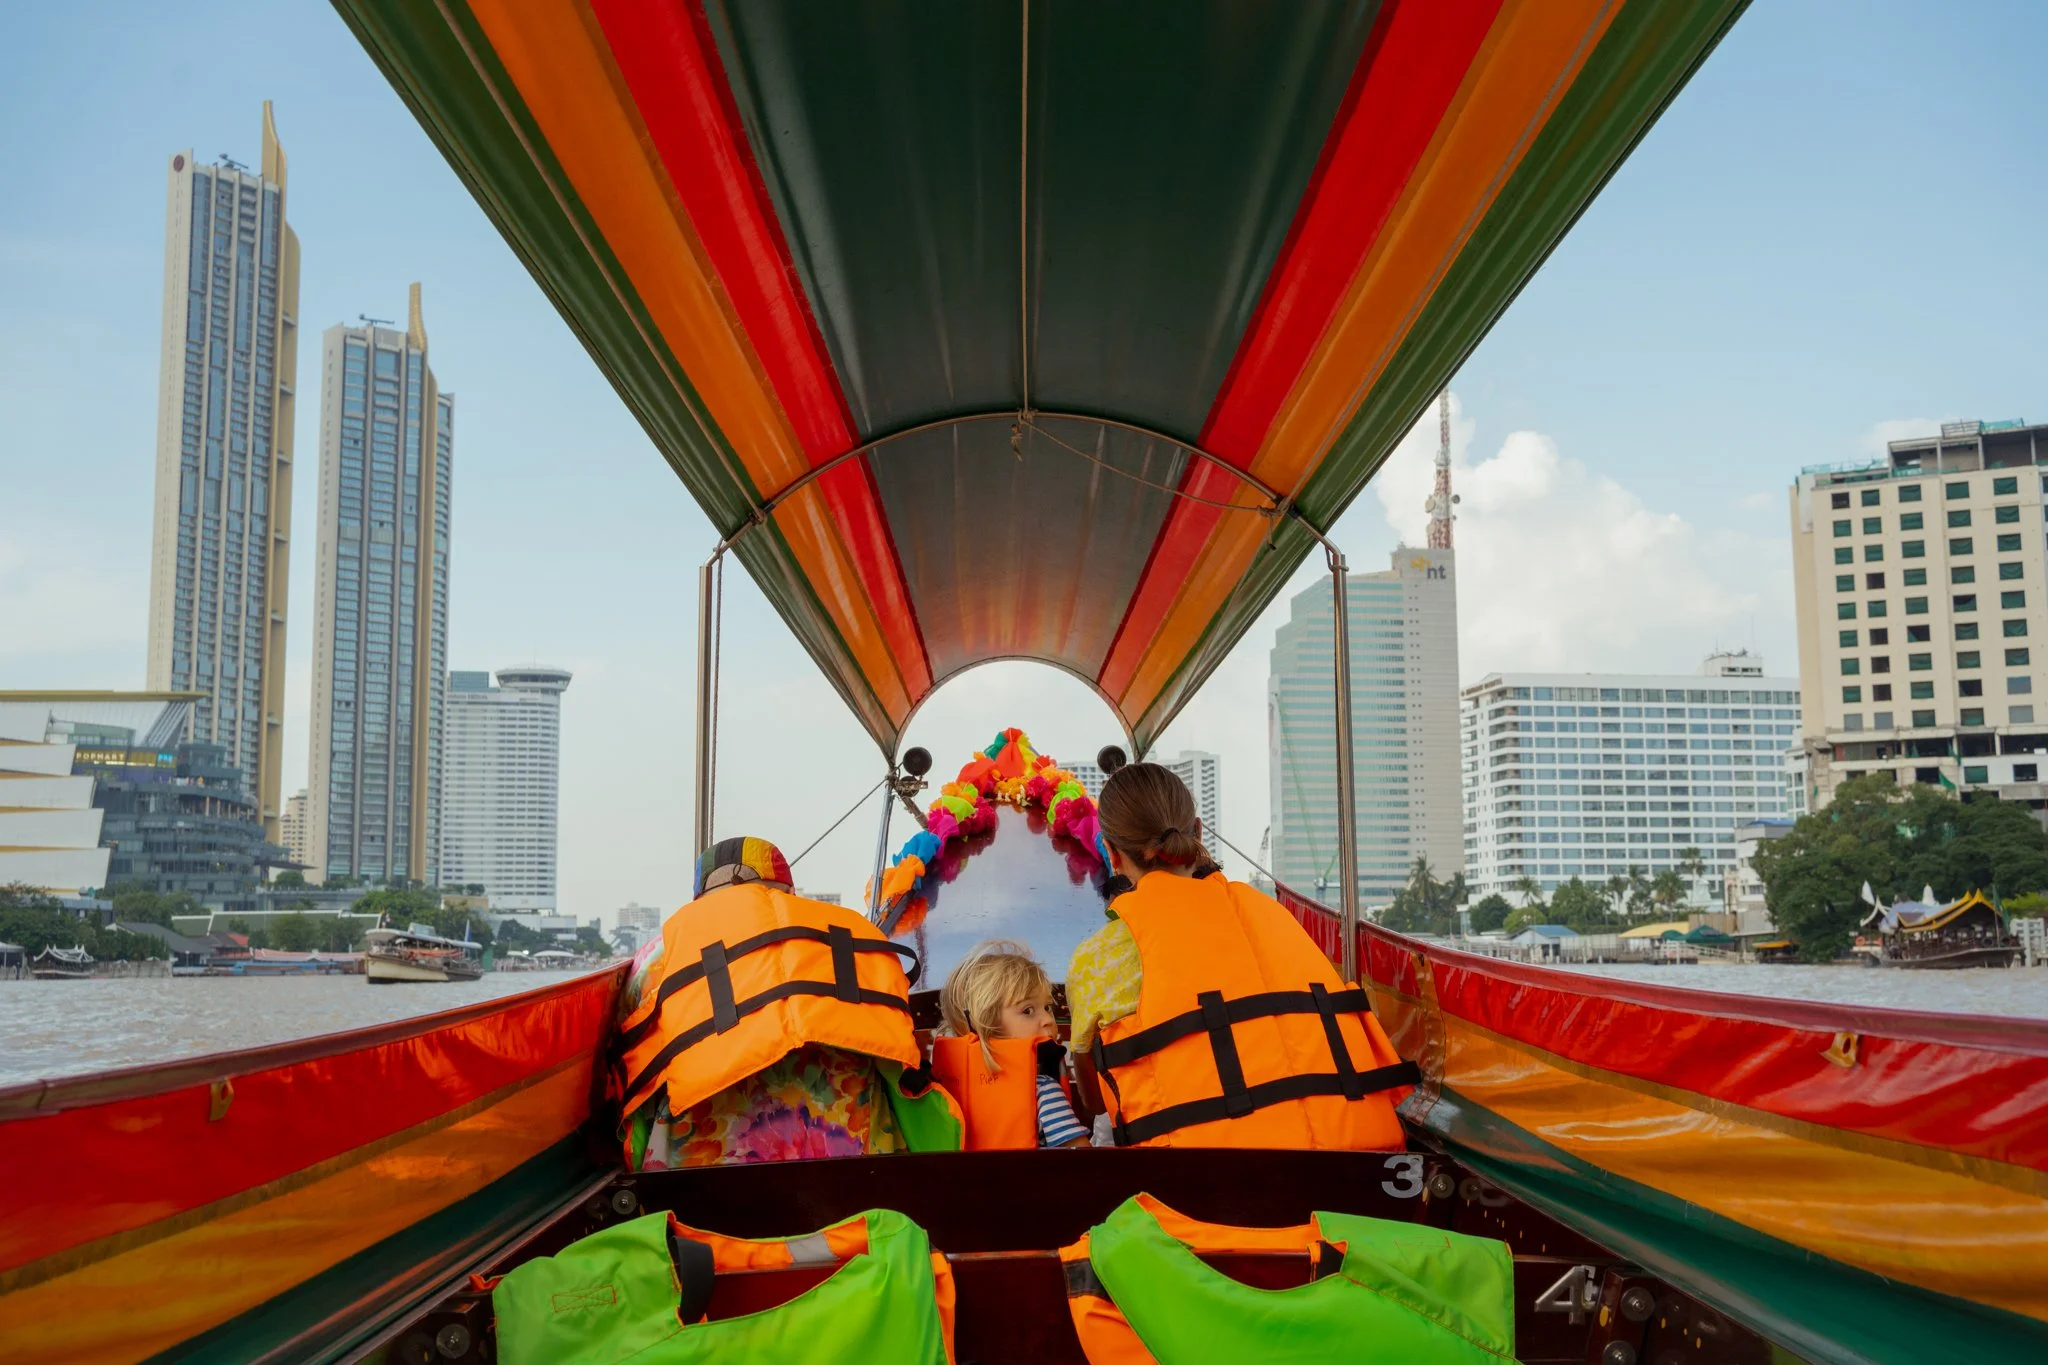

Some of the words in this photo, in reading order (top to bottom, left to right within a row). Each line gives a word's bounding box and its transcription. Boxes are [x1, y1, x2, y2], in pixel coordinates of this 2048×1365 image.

[1427, 565, 1446, 579] nt
[1381, 1154, 1424, 1198] 3
[1534, 1265, 1598, 1325] 4
